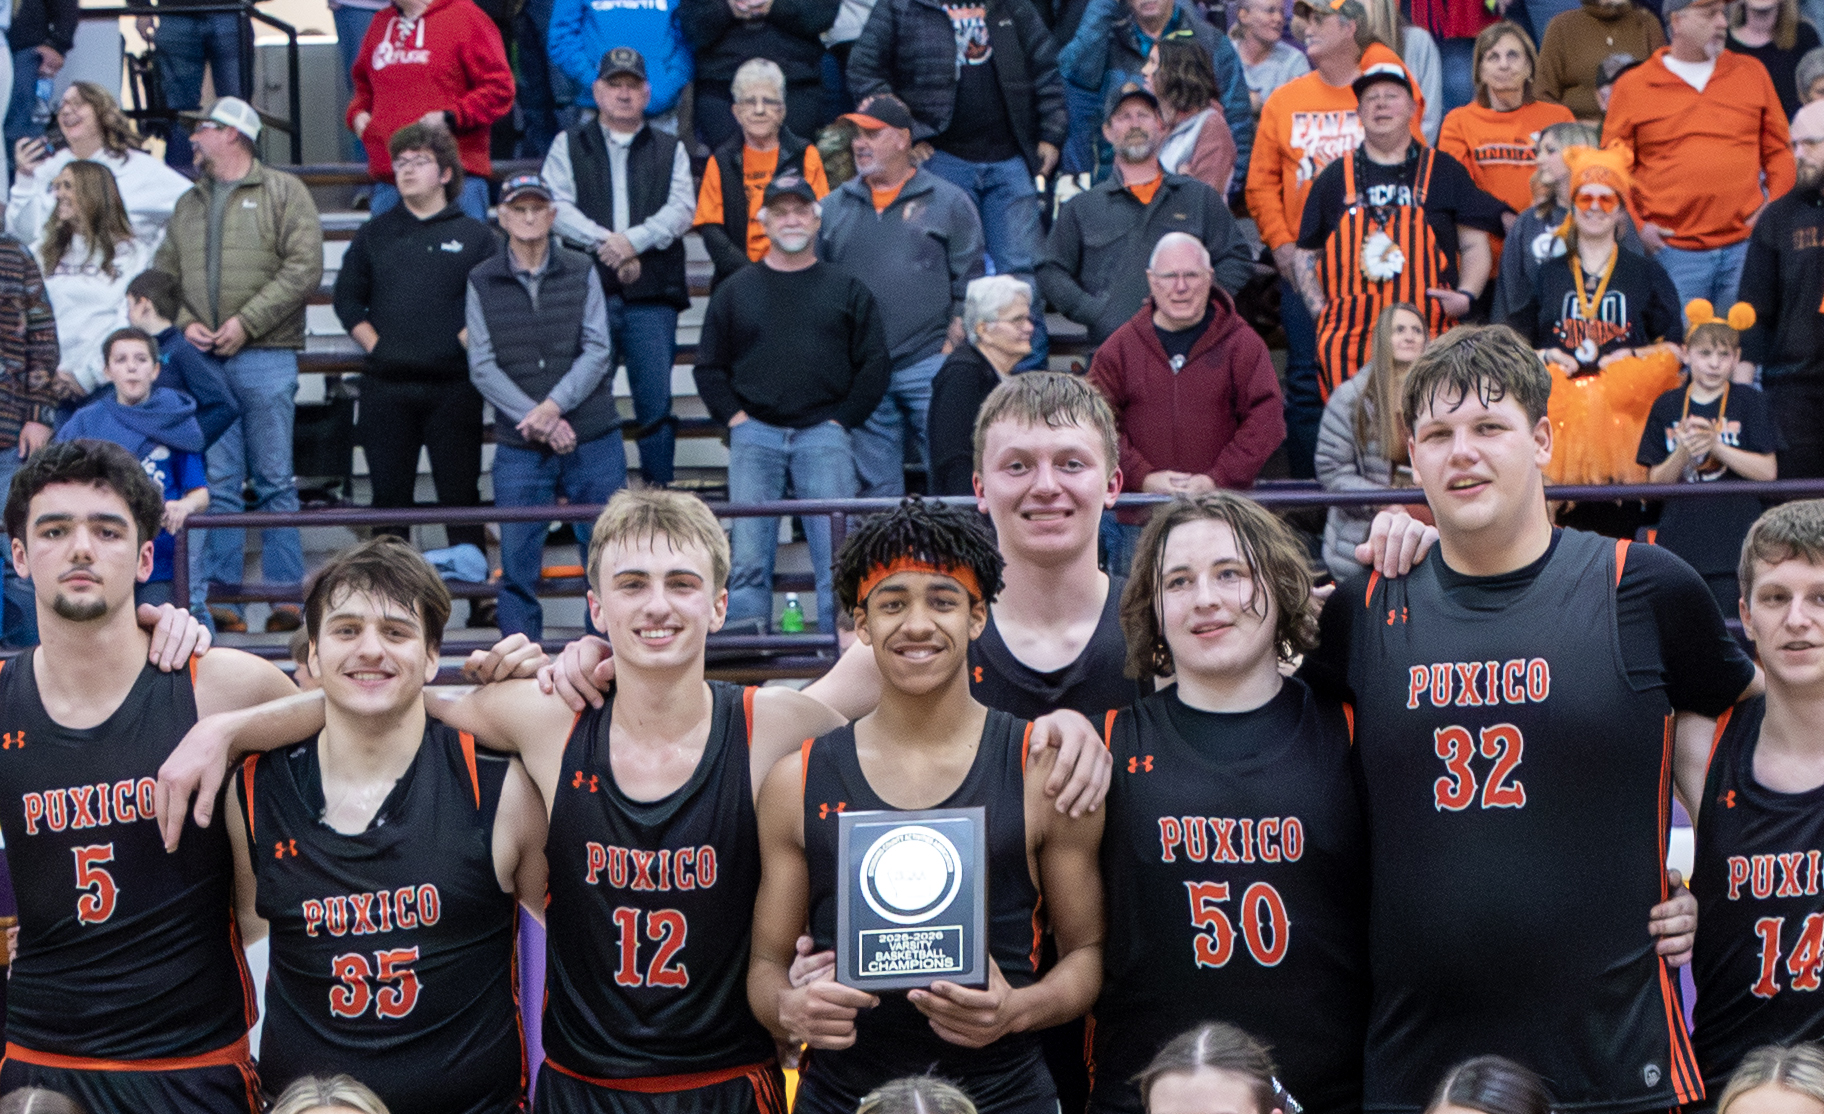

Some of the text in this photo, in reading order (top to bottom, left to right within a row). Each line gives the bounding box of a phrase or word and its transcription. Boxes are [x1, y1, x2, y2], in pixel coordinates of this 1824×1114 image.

[1407, 657, 1550, 709] PUXICO
[1434, 723, 1526, 811] 32
[23, 779, 158, 835] PUXICO
[586, 841, 717, 891] PUXICO
[1158, 816, 1303, 863] PUXICO
[72, 844, 117, 925] 5
[302, 883, 441, 937] PUXICO
[613, 907, 690, 989] 12
[888, 940, 933, 951] VARSITY
[1183, 880, 1291, 968] 50
[868, 957, 954, 972] CHAMPIONS
[875, 948, 946, 962] BASKETBALL
[329, 948, 422, 1019] 35
